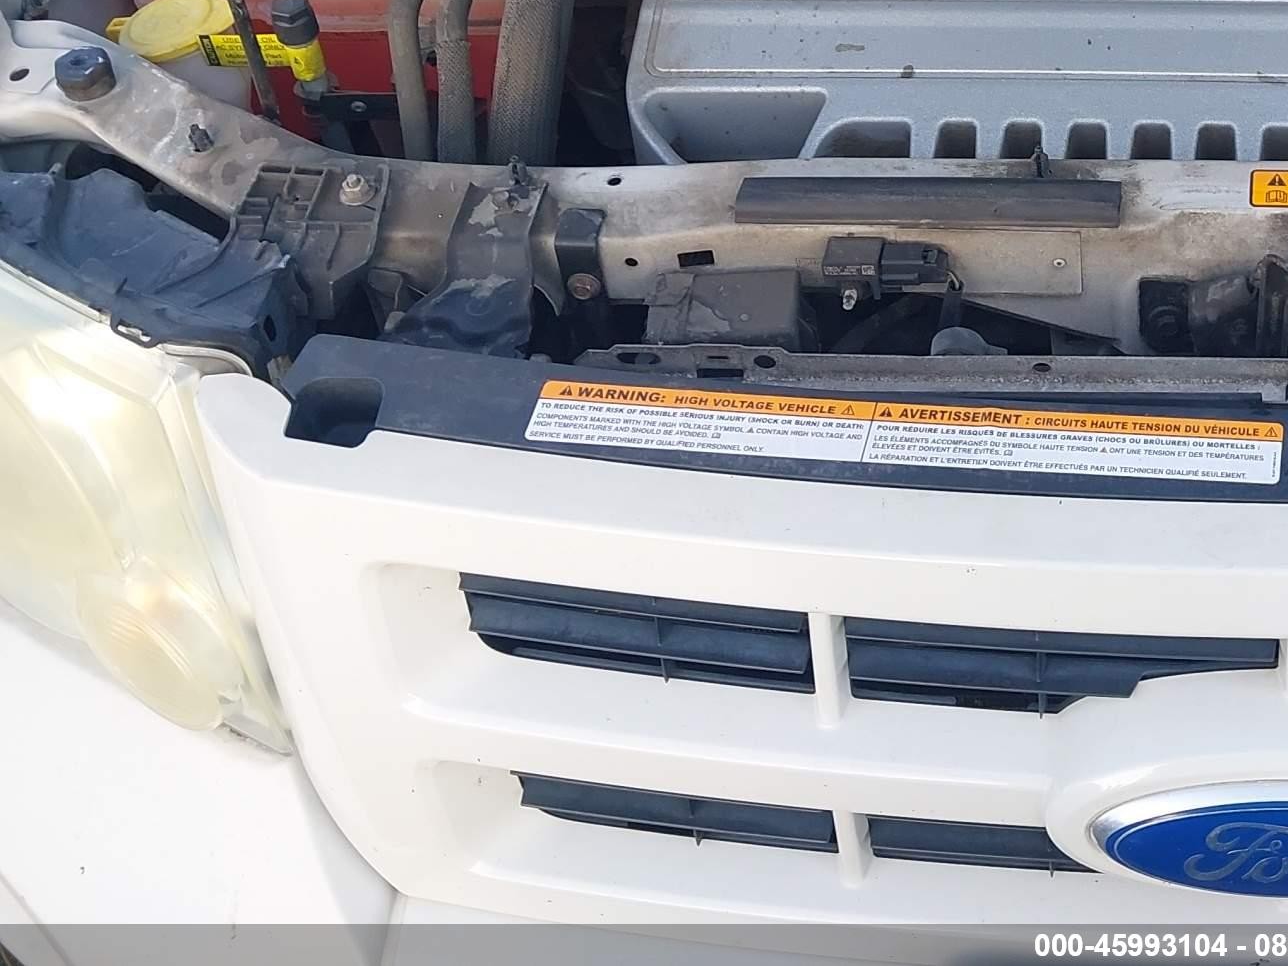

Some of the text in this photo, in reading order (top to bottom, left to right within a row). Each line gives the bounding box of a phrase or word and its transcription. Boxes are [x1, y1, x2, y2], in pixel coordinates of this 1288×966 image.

[577, 386, 836, 414] WARNING: HIGH VOLTAGE VEHICLE
[536, 412, 588, 421] COMPONENTS
[588, 416, 621, 424] MARKED
[678, 422, 712, 430] VOLTAGE
[713, 424, 744, 433] SYMBOL
[755, 427, 789, 435] CONTAIN
[810, 431, 845, 439] VOLTAGE
[638, 409, 678, 417] POSSIBLE
[679, 411, 714, 420] SERIOUS
[716, 414, 746, 422] INJURY
[747, 416, 779, 424] (SHOCK
[794, 419, 820, 427] BURN)
[898, 408, 1259, 436] AVERTISSEMENT CIRCUITS HAUTE TENSION DU VÉHICULE
[528, 430, 561, 438] SERVICE
[596, 435, 643, 444] PERFORMED
[655, 439, 695, 447] QUALIFIED
[696, 442, 741, 451] PERSONNEL
[989, 440, 1000, 448] DU
[1001, 441, 1038, 449] SYMBOLE
[1039, 443, 1064, 451] HAUTE
[1143, 448, 1176, 456] TENSION
[1009, 431, 1057, 440] BLESSURES
[1060, 434, 1093, 442] GRAVES
[1095, 435, 1126, 443] (CHOCS
[1206, 441, 1255, 449] MORTELLES
[879, 453, 928, 462] RÉPARATION
[1090, 464, 1105, 472] PAR
[1119, 466, 1164, 474] TECHNICIEN
